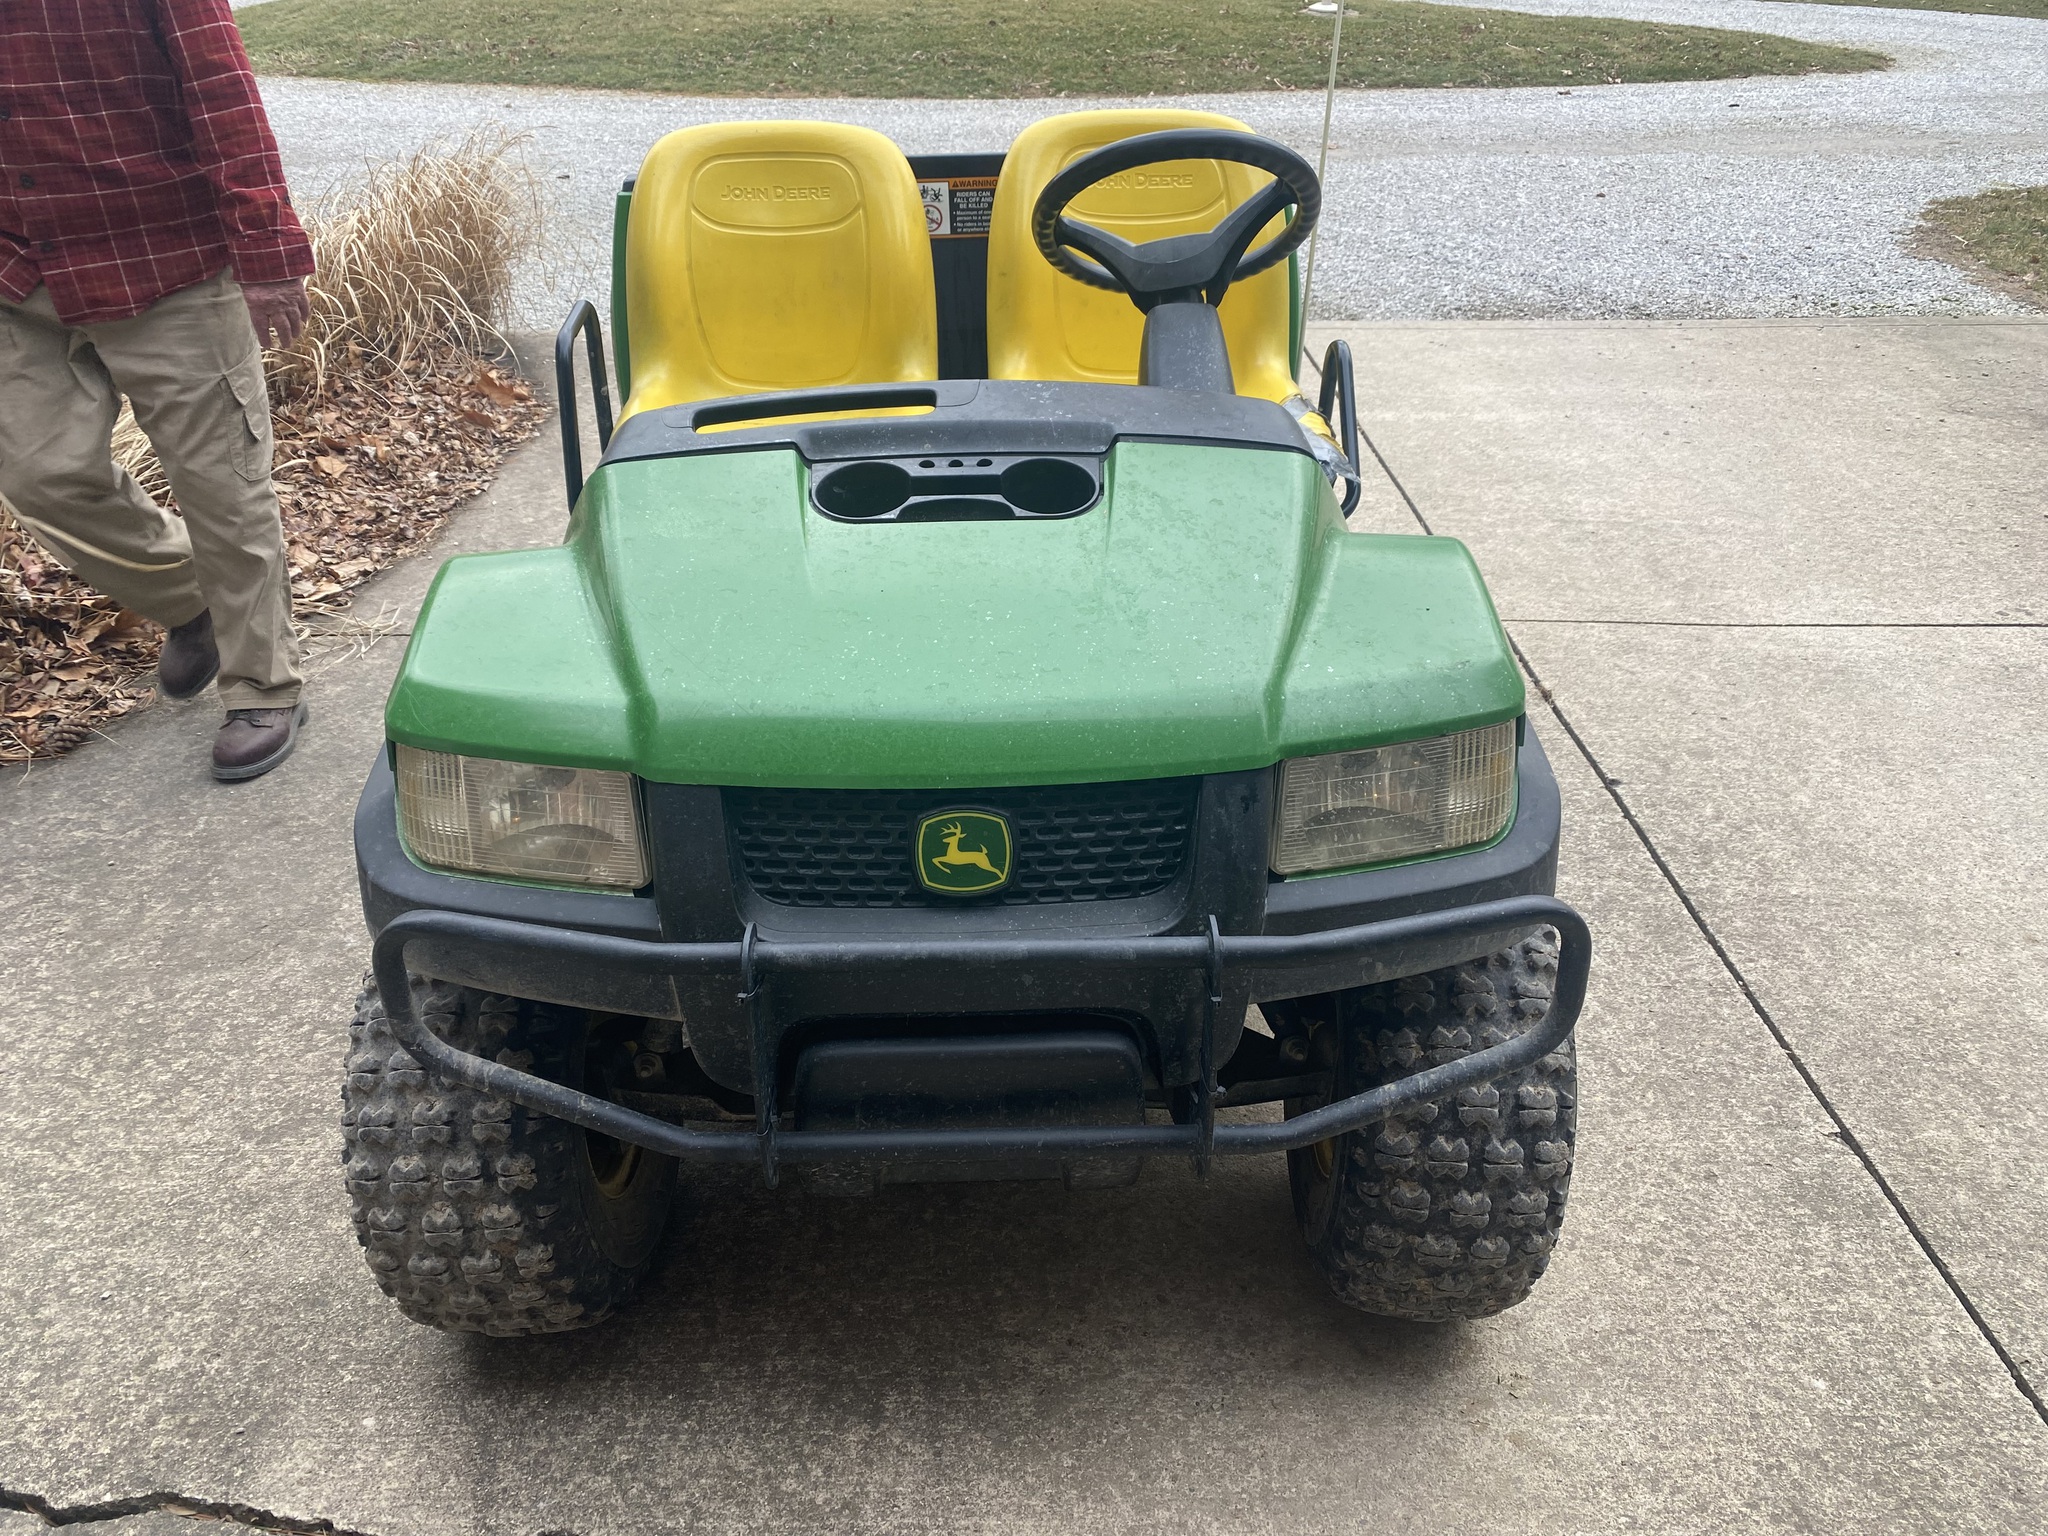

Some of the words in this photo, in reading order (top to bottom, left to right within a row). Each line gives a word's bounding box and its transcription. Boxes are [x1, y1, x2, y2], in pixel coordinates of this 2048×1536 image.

[1134, 172, 1193, 189] DEERE
[720, 184, 769, 201] JOHN
[772, 185, 831, 201] DEERE
